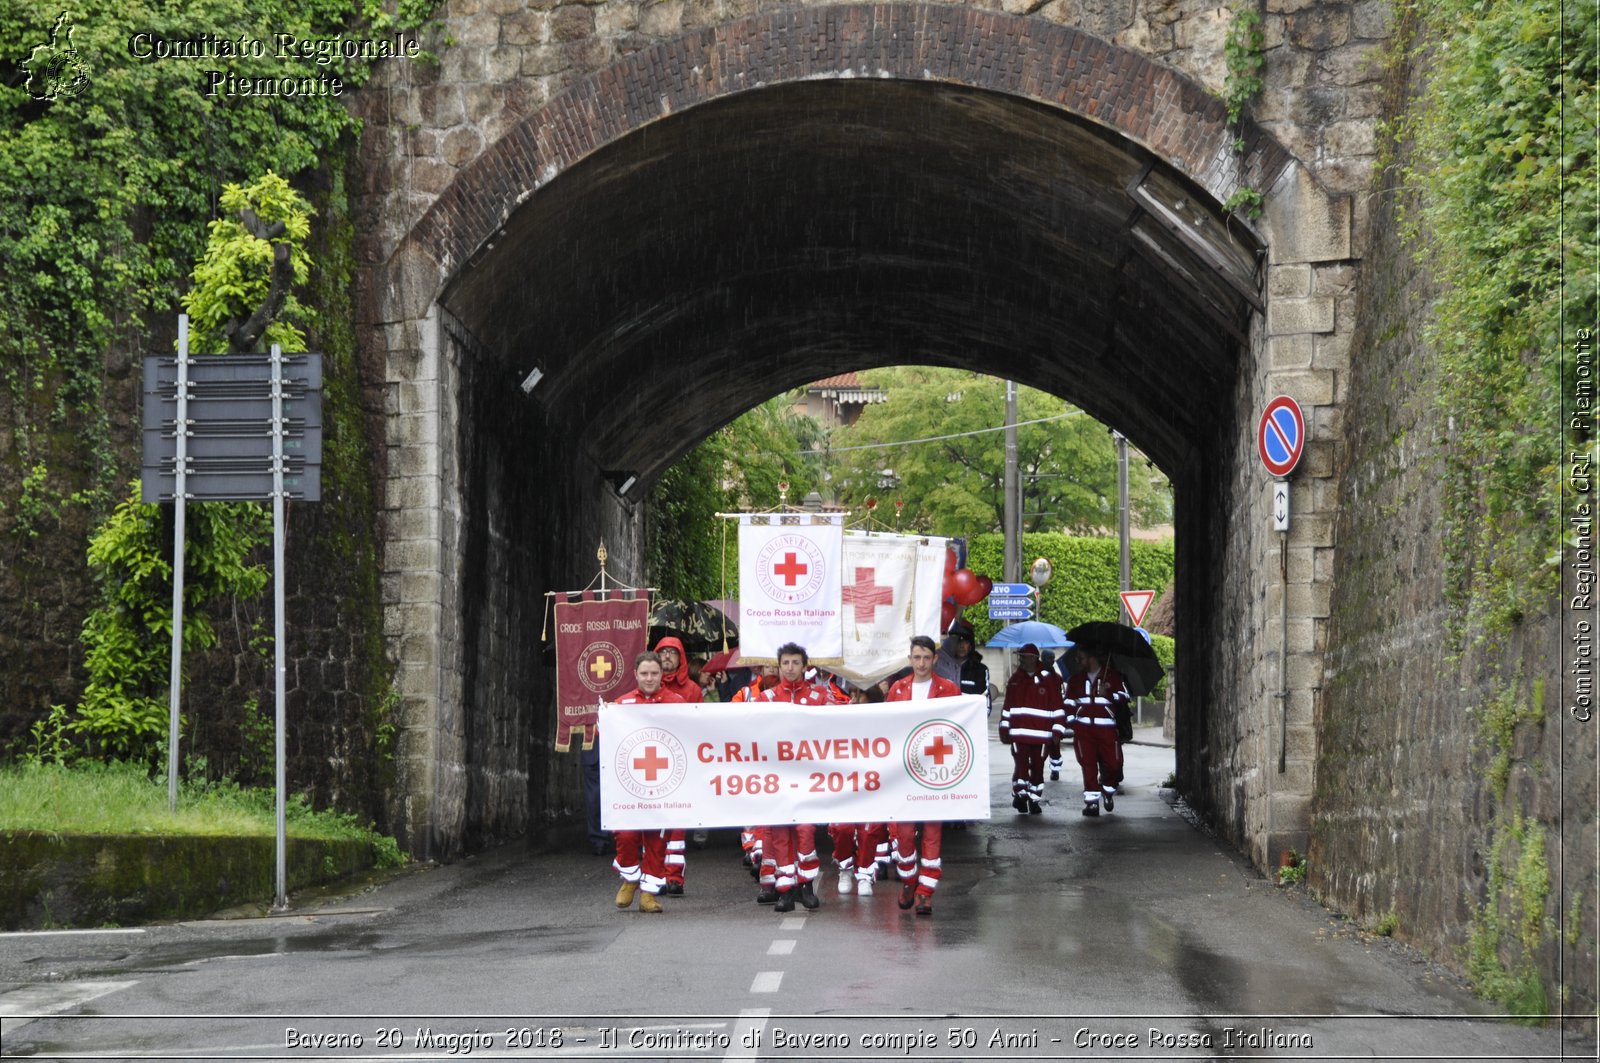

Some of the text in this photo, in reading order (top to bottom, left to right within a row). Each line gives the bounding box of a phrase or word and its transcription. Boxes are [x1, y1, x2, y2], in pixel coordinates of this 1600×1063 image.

[746, 609, 835, 617] Croce Rossa Italiana
[560, 618, 642, 633] CROCE ROSSA ITALIANA
[697, 737, 891, 763] C.R.I. BAVENO
[618, 746, 646, 796] CONVENZIONE
[637, 730, 671, 745] GINEVRA
[670, 753, 684, 785] AGOSTO
[709, 774, 780, 796] 1968
[809, 771, 881, 793] 2018
[929, 766, 949, 781] 50
